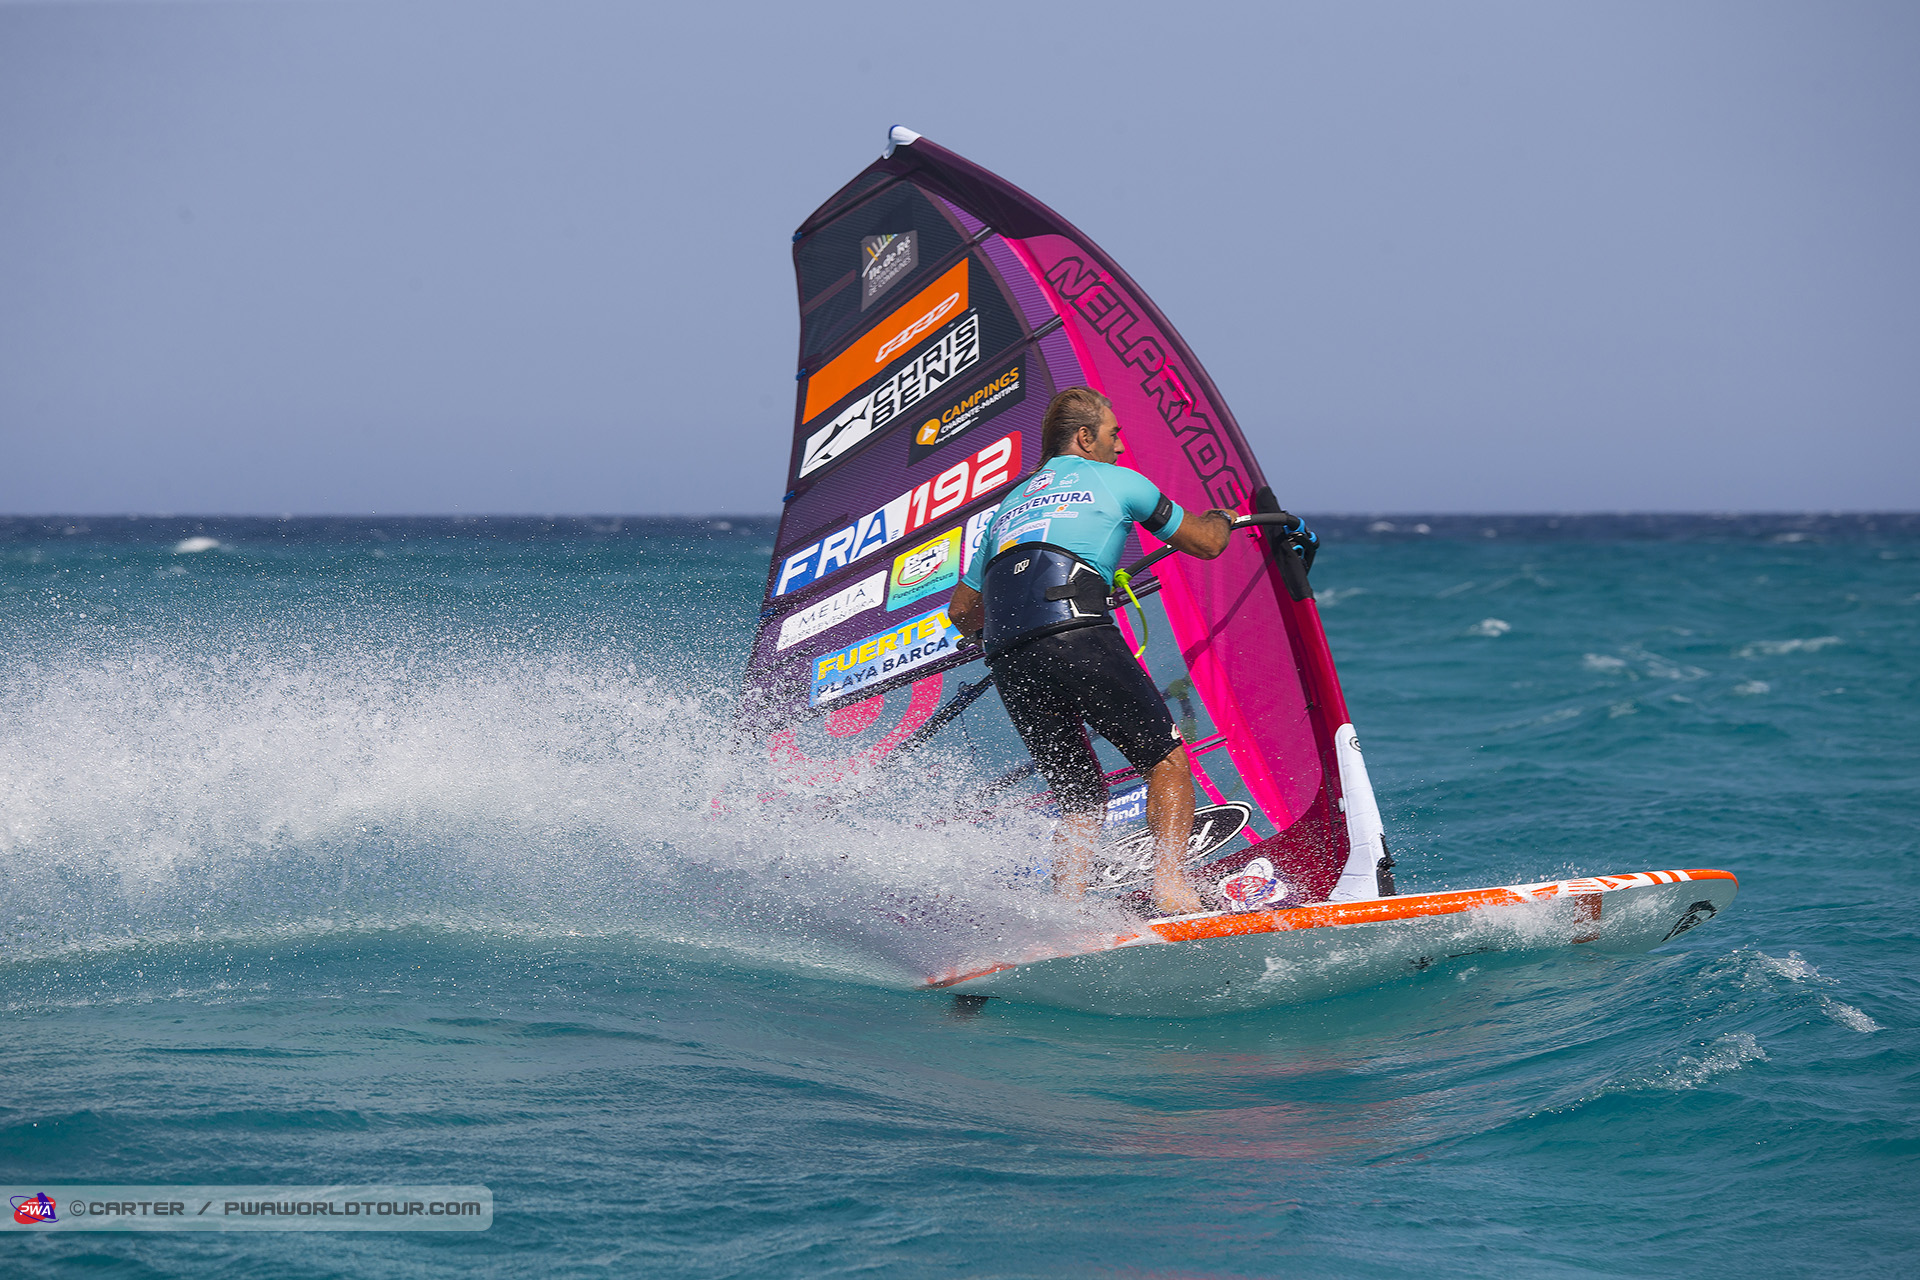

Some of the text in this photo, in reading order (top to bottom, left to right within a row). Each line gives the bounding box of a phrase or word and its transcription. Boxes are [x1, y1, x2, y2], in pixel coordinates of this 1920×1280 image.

[871, 343, 979, 431] BENZ
[873, 320, 977, 409] CHRIS
[941, 367, 1020, 423] CAMPINGS
[1044, 256, 1249, 509] NEILPRYDE
[775, 508, 889, 596] FRA
[911, 436, 1013, 528] 192
[892, 572, 954, 600] Fuerteventura
[816, 637, 949, 698] PLAYA BARCA
